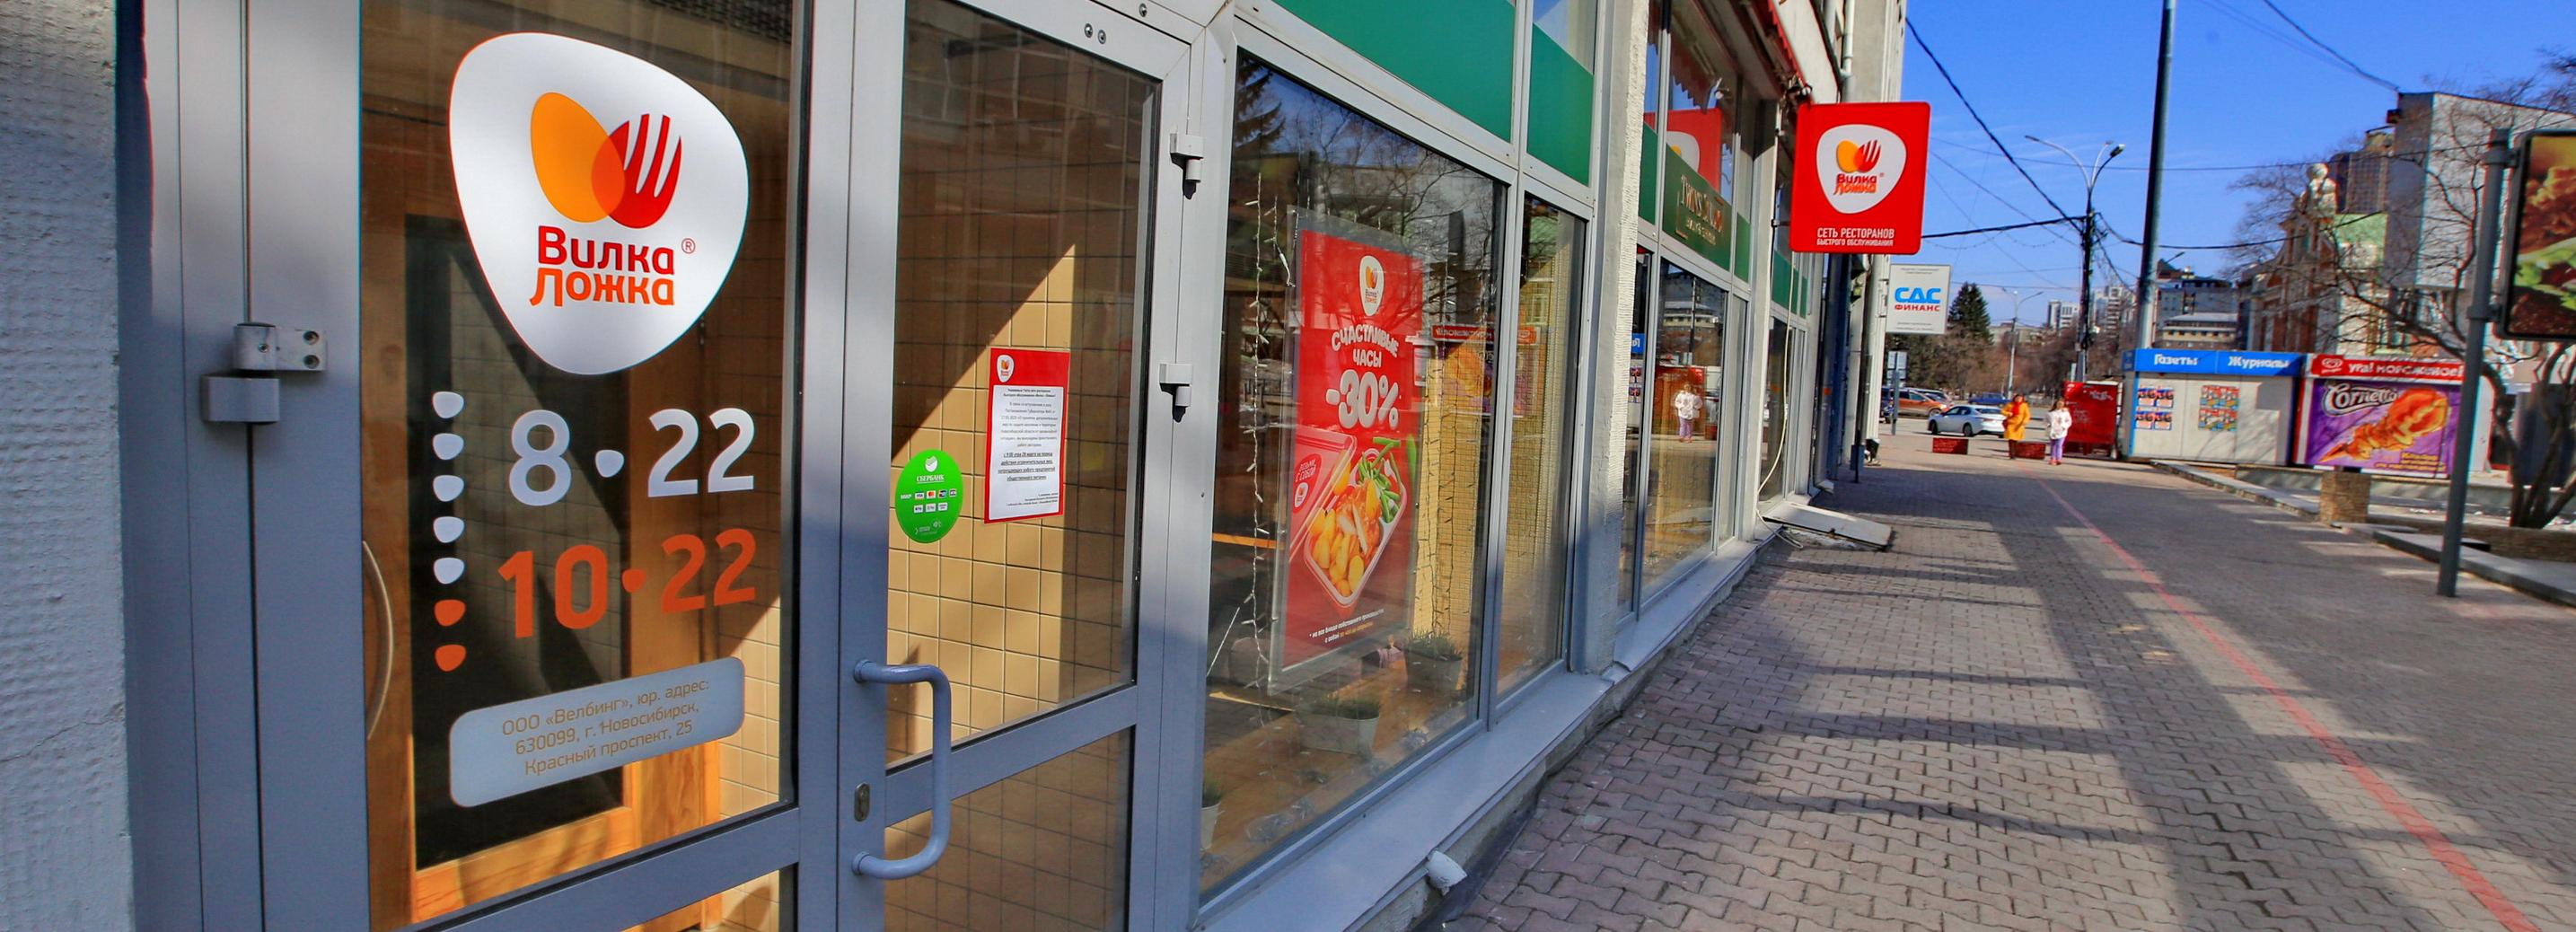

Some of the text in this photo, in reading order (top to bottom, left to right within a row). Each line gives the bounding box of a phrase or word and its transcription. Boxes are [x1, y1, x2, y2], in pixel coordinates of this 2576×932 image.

[1833, 182, 1877, 195] Ложка
[1836, 173, 1877, 184] Вилка
[1816, 238, 1894, 247] БЫСТРОГО ОБСЛУЖИВАНИЯ
[1817, 227, 1895, 239] СЕТЬ РЕСТОРАНОВ
[538, 225, 675, 276] Вилка
[530, 267, 675, 307] Ложка
[1332, 324, 1400, 358] СЧАСТЛИВЫЕ
[1353, 348, 1383, 368] ЧАСЫ
[2154, 354, 2290, 369] Газеты Журналы
[1326, 369, 1399, 429] -30%
[2324, 383, 2399, 416] Cornetto
[917, 474, 945, 483] СБЕРБАНК
[503, 679, 709, 735] ООО «Велбинг», юр. адрес:
[515, 702, 699, 755] 630099, г. Новосибирск,
[524, 720, 693, 776] Красный проспект, 25
